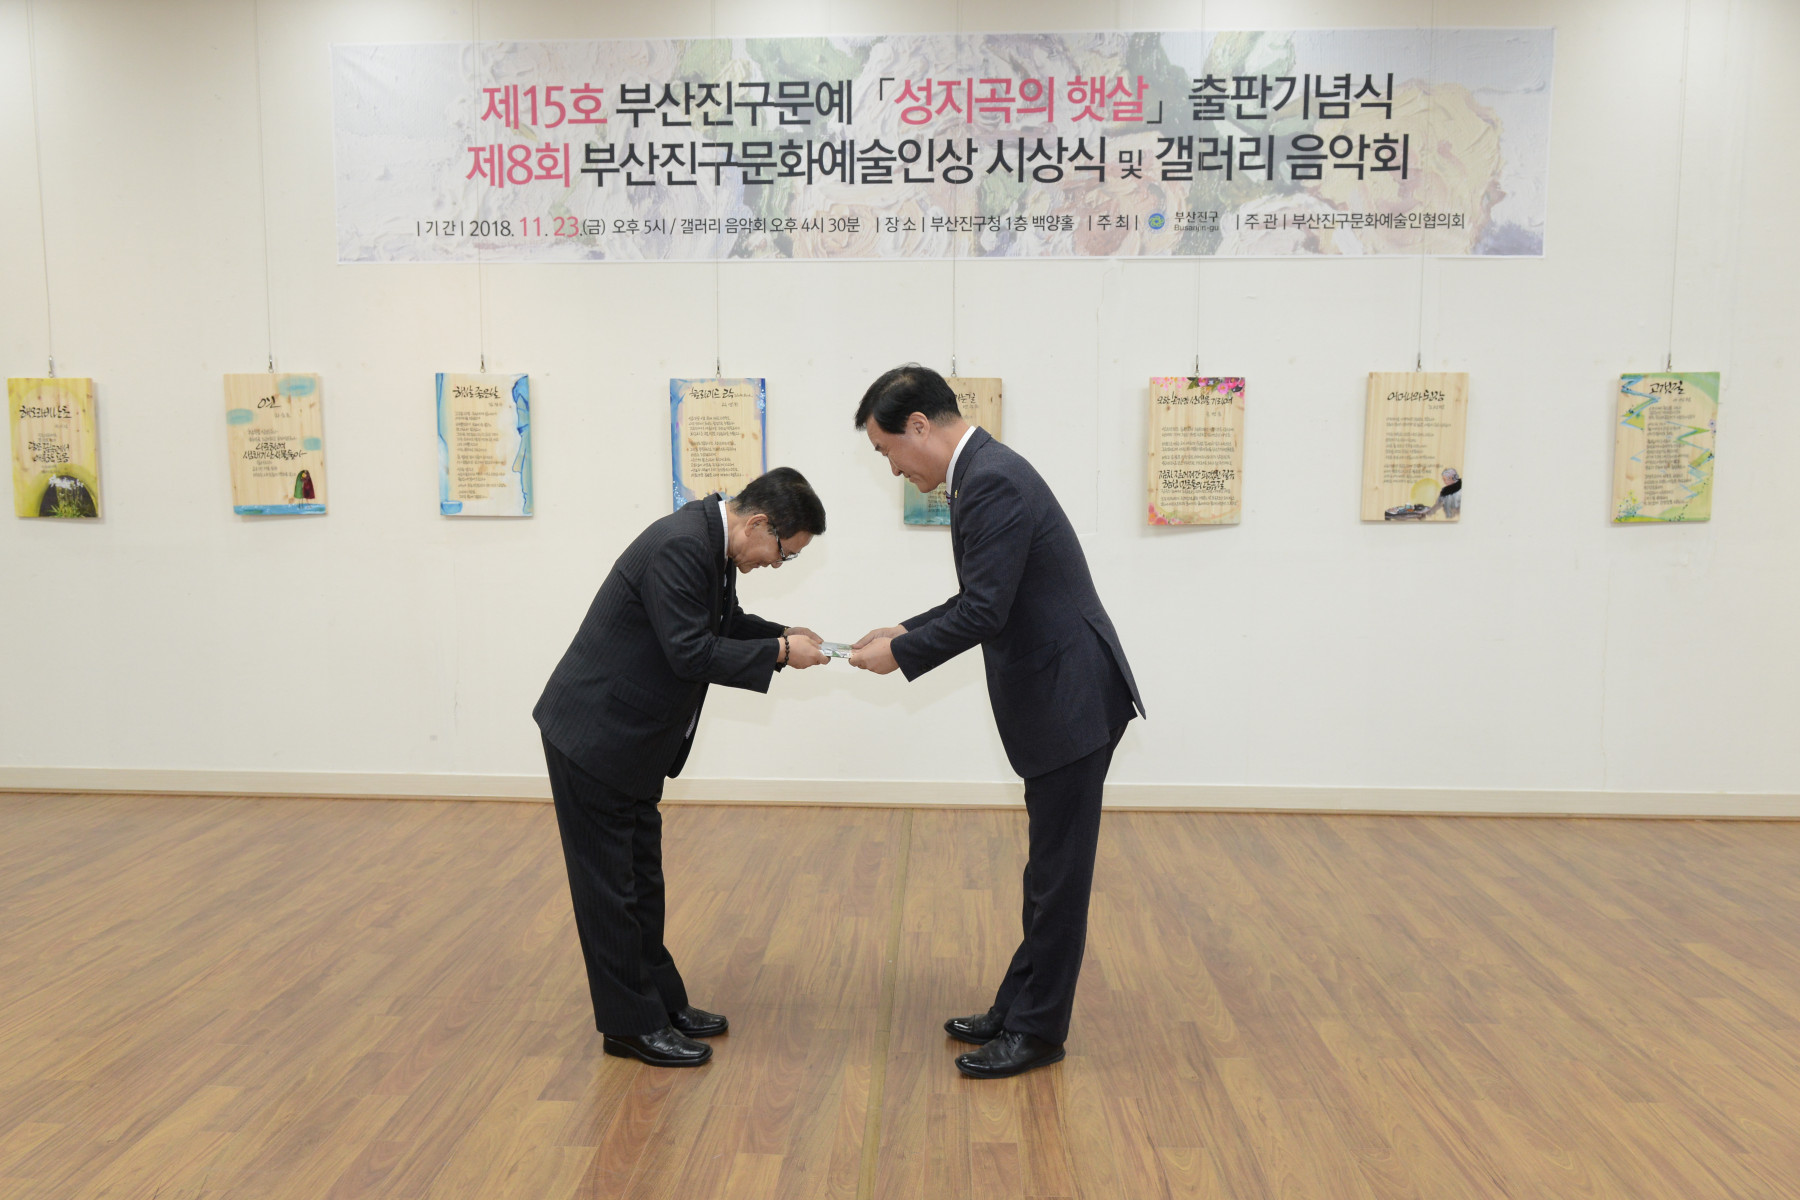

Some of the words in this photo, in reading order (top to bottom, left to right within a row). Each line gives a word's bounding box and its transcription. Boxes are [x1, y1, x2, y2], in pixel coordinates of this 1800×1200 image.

[481, 83, 607, 129] 제15호
[616, 80, 852, 127] 부산진구문예
[1188, 73, 1393, 120] 출판기념식
[466, 142, 570, 188] 제8회
[581, 138, 976, 187] 부산진구문화예술인상
[986, 137, 1105, 183] 시상식
[1119, 150, 1142, 179] 및
[1156, 135, 1274, 181] 갤러리
[1286, 133, 1409, 180] 음악회
[613, 219, 639, 234] 오후
[645, 219, 665, 234] 5시
[681, 219, 720, 234] 갤러리
[725, 217, 766, 233] 음악회
[770, 218, 797, 233] 오후
[802, 217, 823, 233] 4시
[829, 217, 860, 232] 30분
[931, 215, 1000, 232] 부산진구청
[1006, 215, 1027, 231] 1층
[1033, 215, 1074, 231] 백양홀
[1176, 211, 1218, 223] 부산진구
[1292, 212, 1464, 229] 부산진구문화예술인협의회
